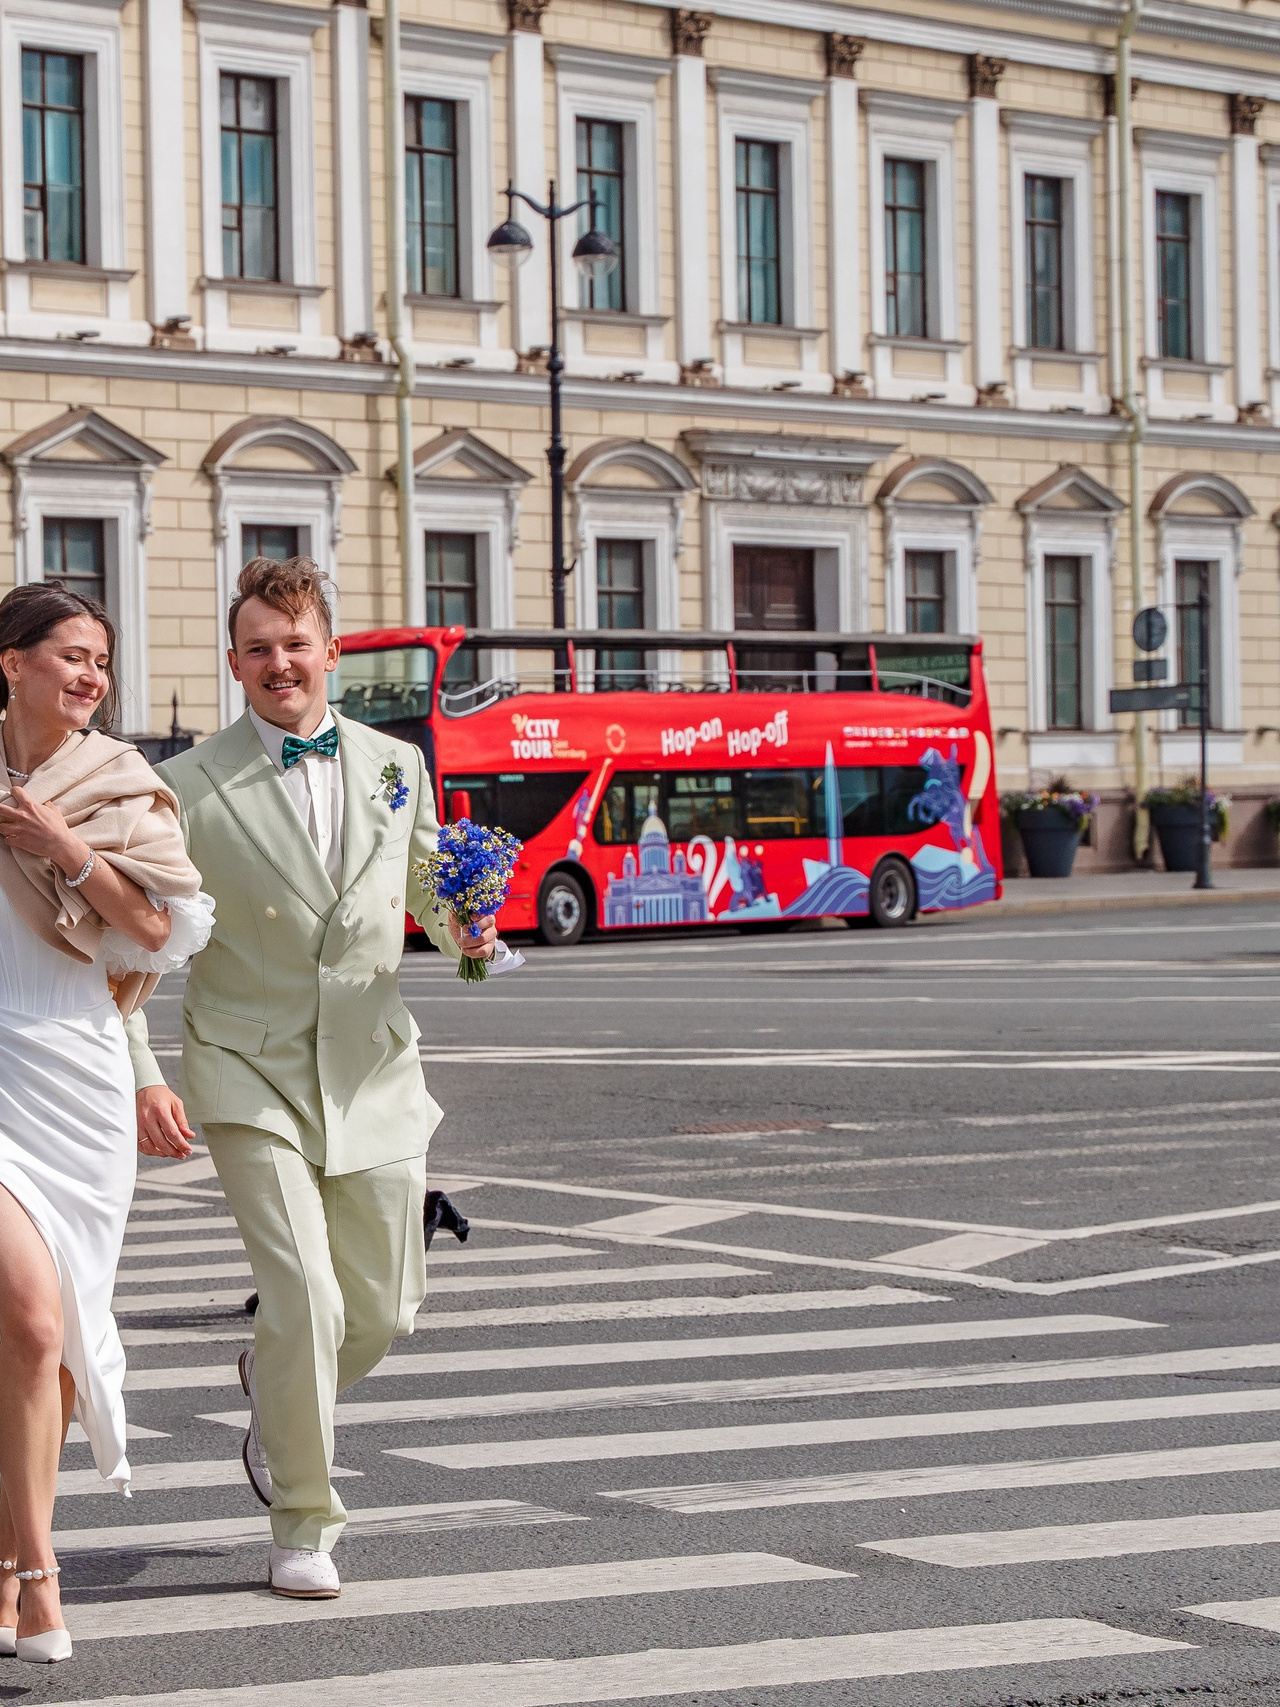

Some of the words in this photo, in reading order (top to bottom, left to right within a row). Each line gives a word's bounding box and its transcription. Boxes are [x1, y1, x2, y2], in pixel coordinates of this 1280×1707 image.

[525, 719, 560, 739] CITY
[661, 717, 723, 757] Hop-on
[727, 709, 789, 757] Hop-off
[510, 739, 553, 759] TOUR
